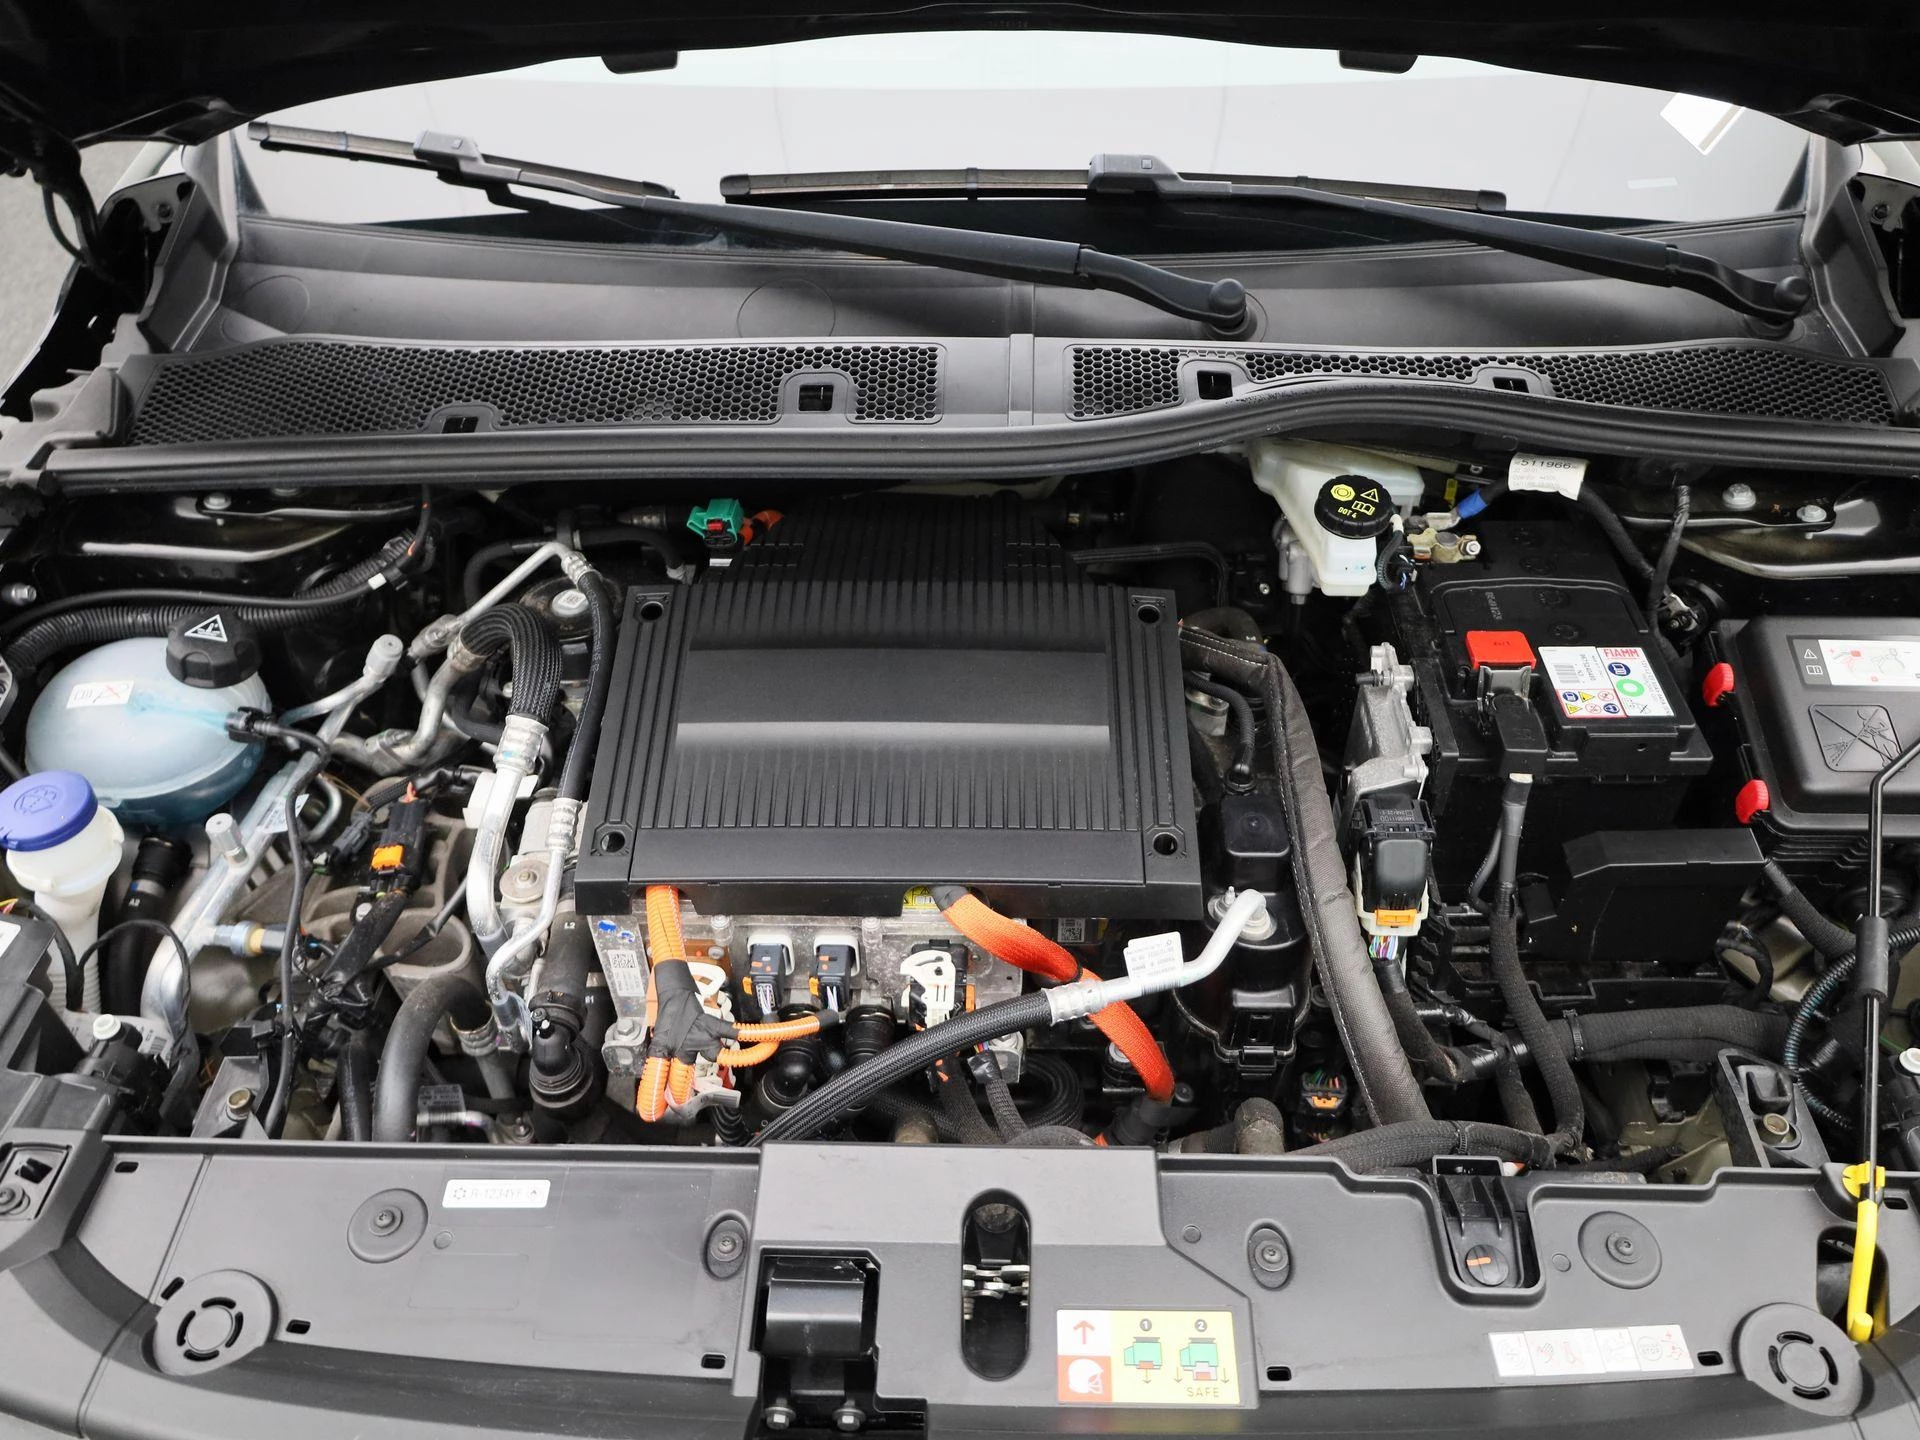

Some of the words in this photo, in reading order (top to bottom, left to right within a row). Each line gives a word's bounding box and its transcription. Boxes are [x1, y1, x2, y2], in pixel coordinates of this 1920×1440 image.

[1520, 460, 1571, 470] 511966
[1338, 507, 1352, 516] DOT
[1603, 649, 1639, 658] FIAMM
[1186, 1386, 1220, 1398] SAFE
